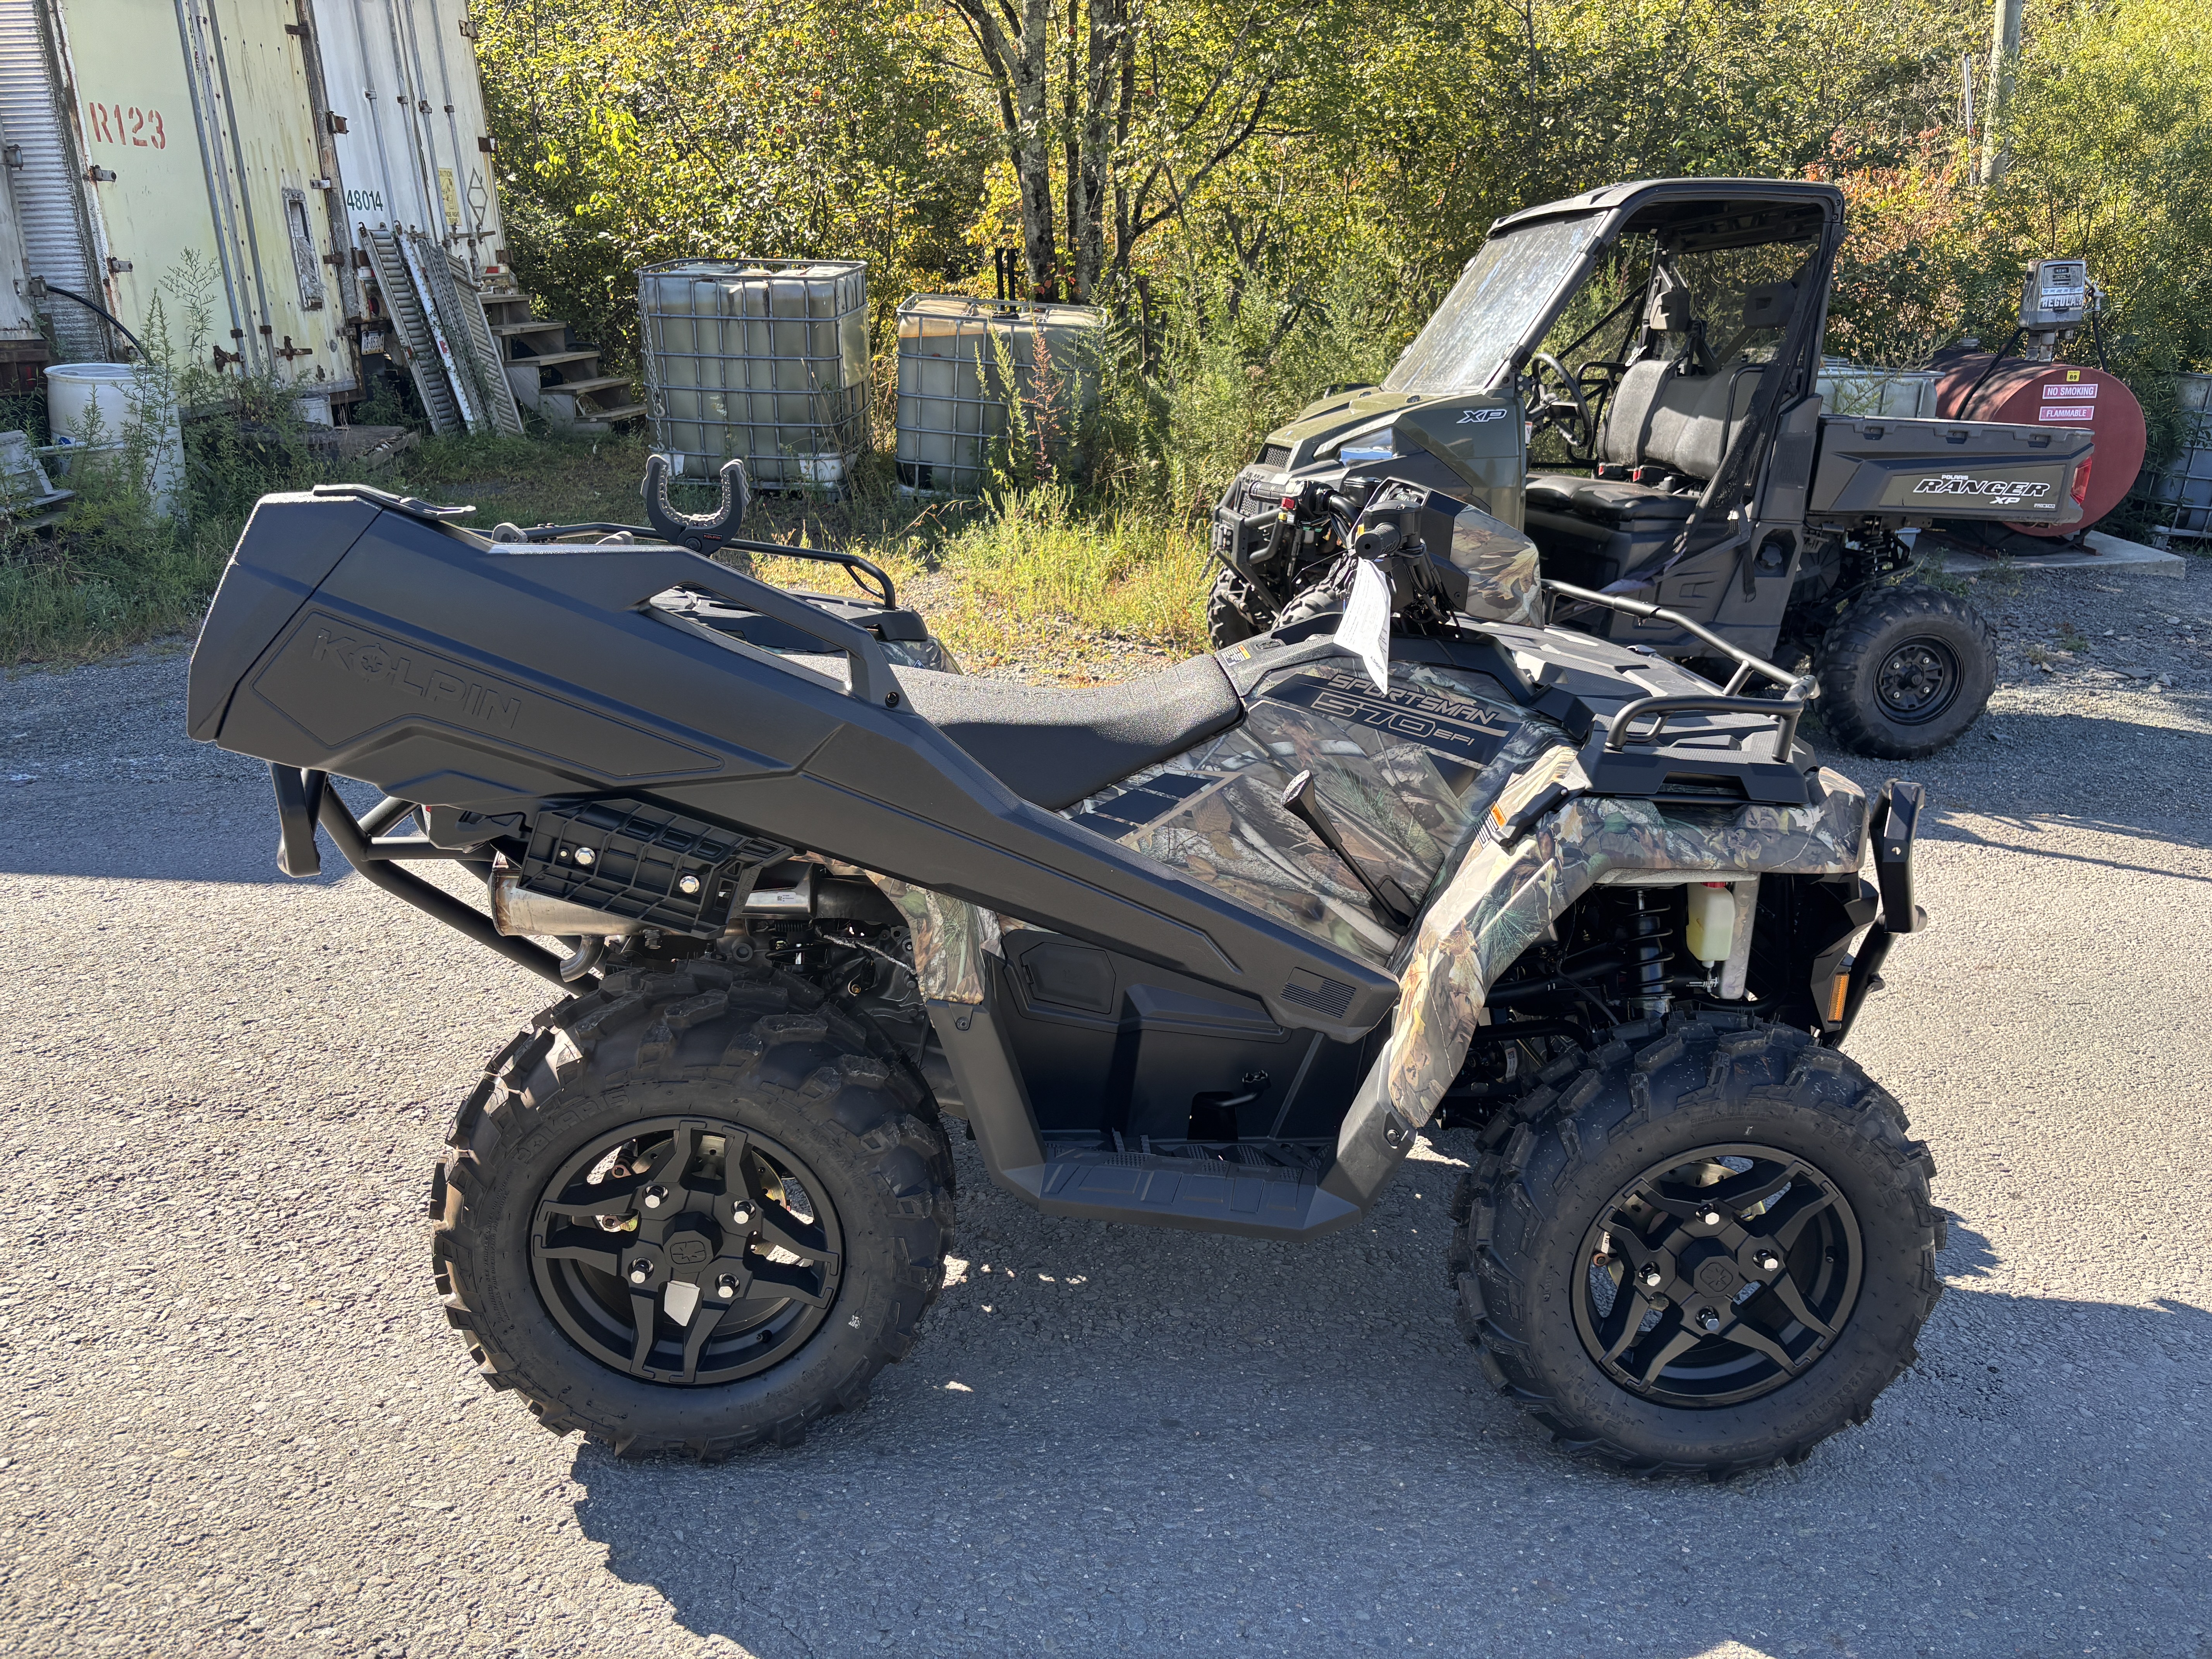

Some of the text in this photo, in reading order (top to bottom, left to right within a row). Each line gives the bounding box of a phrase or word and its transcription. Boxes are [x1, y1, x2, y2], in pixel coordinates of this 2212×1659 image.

[89, 102, 166, 149] R123
[347, 189, 383, 212] 48014
[2041, 295, 2082, 307] REGULAR
[2047, 386, 2094, 396] NO SMOKING
[1456, 409, 1508, 424] XP
[2046, 409, 2087, 417] FLAMMABLE
[1913, 479, 2050, 497] RANGER
[311, 627, 521, 729] KOLPIN
[1328, 675, 1496, 725] SPORTSMAN
[1310, 692, 1475, 746] 570 EFI
[513, 1088, 631, 1164] POLARIS
[1812, 1120, 1904, 1207] POLARIS
